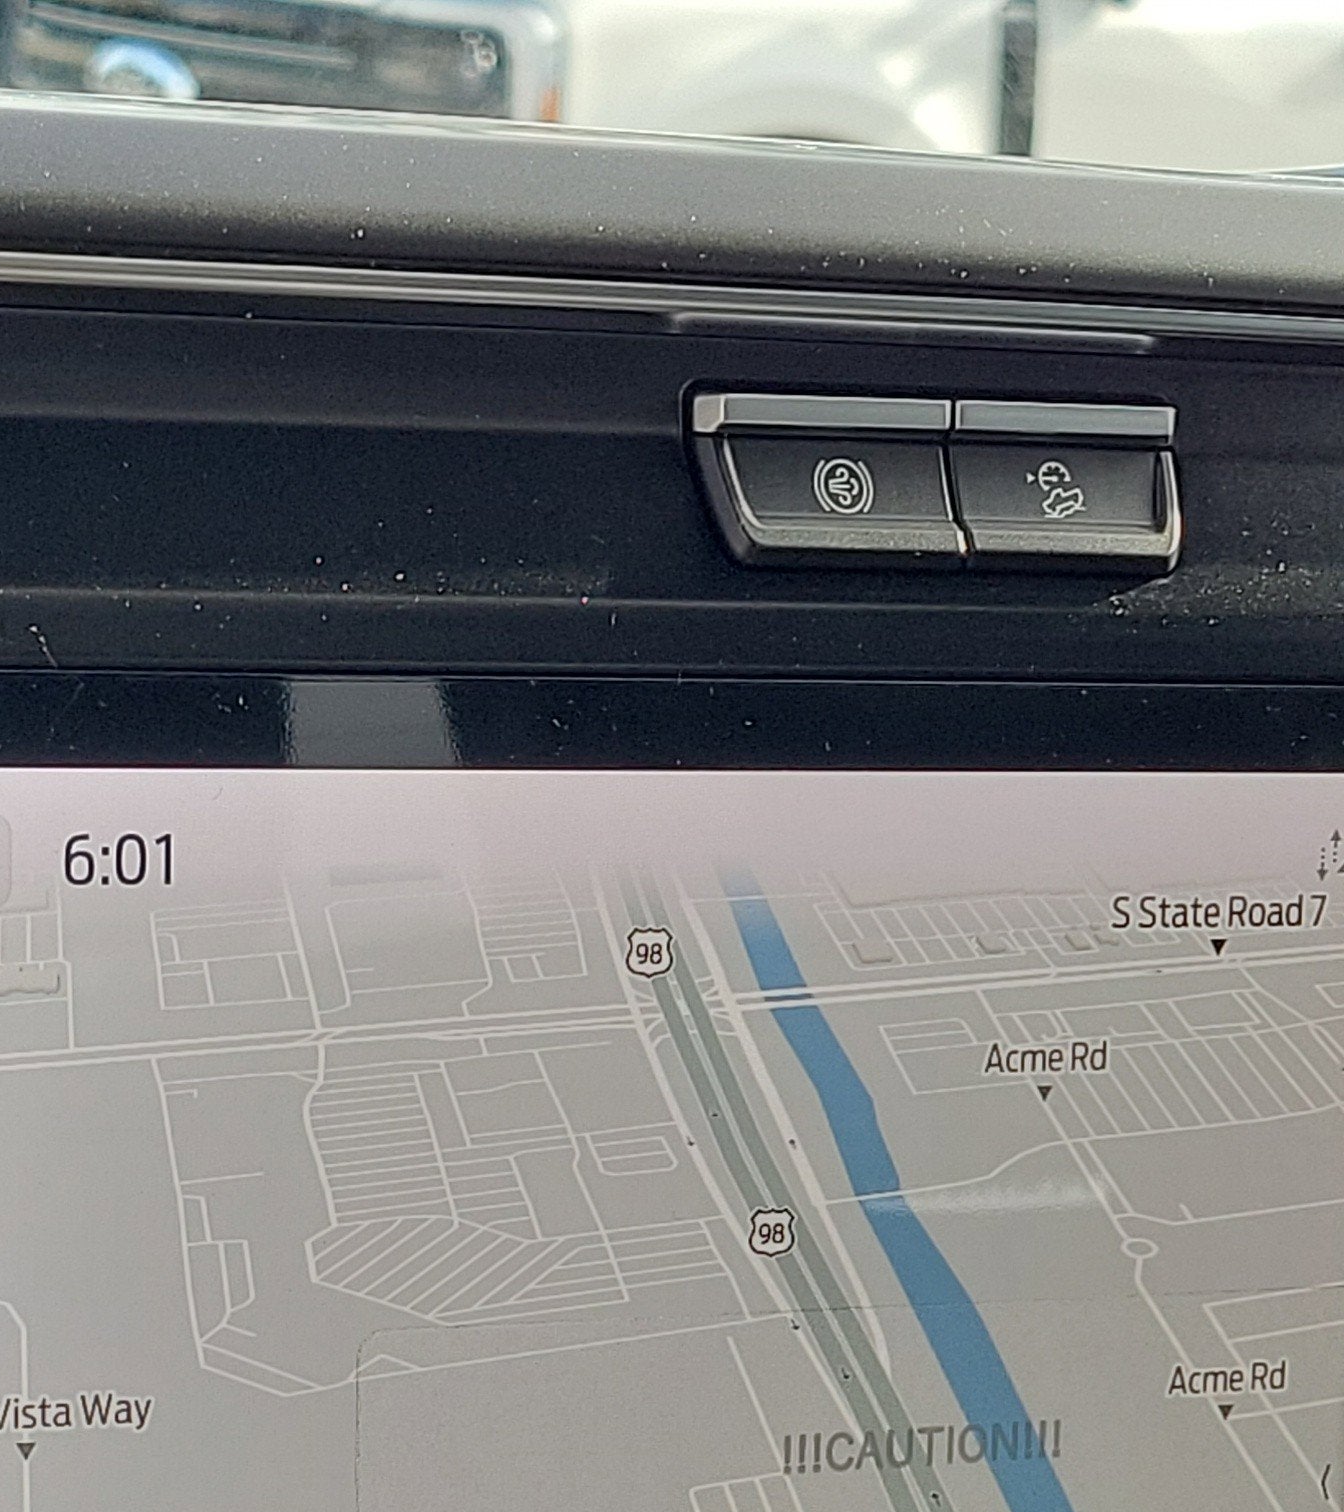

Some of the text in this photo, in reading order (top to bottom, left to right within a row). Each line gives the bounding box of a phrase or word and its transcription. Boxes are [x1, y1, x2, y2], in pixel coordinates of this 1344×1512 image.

[63, 833, 174, 886] 6:01
[1112, 895, 1327, 930] S State Road 7
[636, 941, 664, 966] 98
[984, 1041, 1108, 1074] Acme Rd
[758, 1221, 786, 1246] 98
[1167, 1361, 1286, 1396] Acme Rd
[80, 1393, 152, 1431] Way
